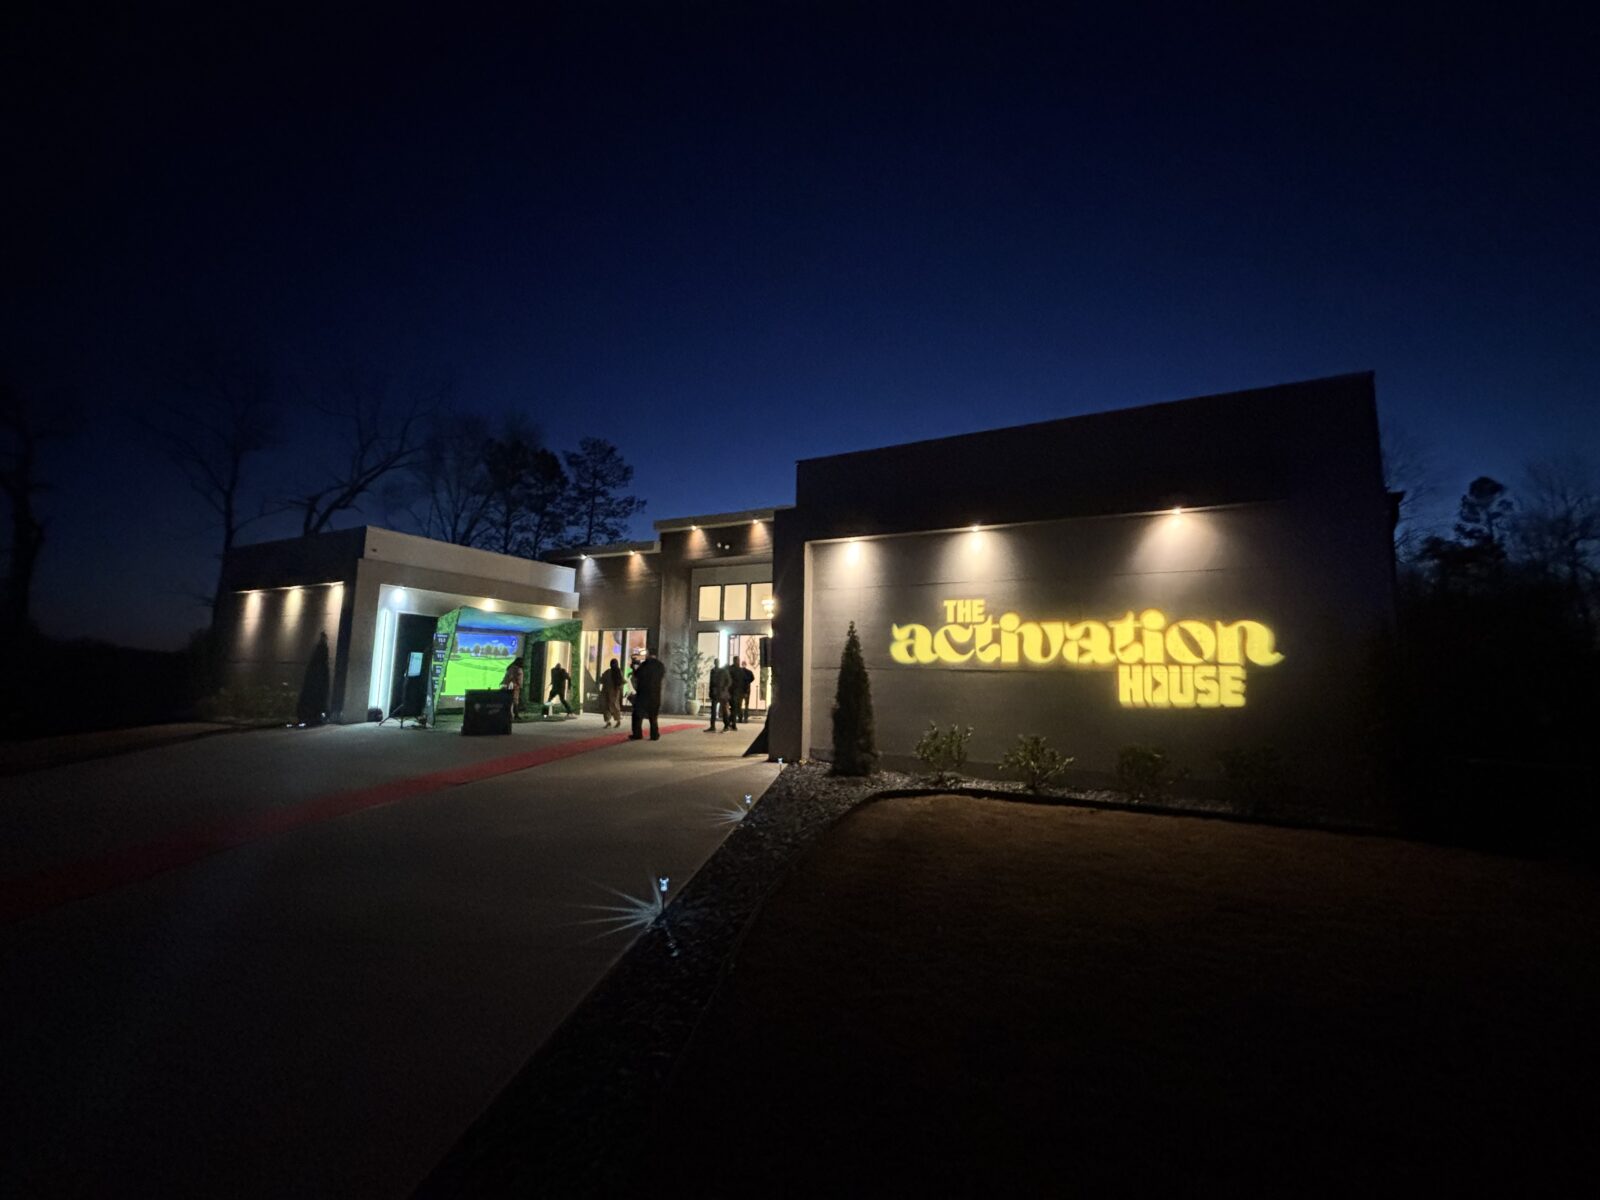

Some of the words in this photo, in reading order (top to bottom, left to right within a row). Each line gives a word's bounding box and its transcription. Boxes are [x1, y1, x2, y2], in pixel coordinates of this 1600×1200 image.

[943, 599, 986, 624] THE
[889, 608, 1285, 667] activation
[1118, 664, 1247, 708] HOUSE
